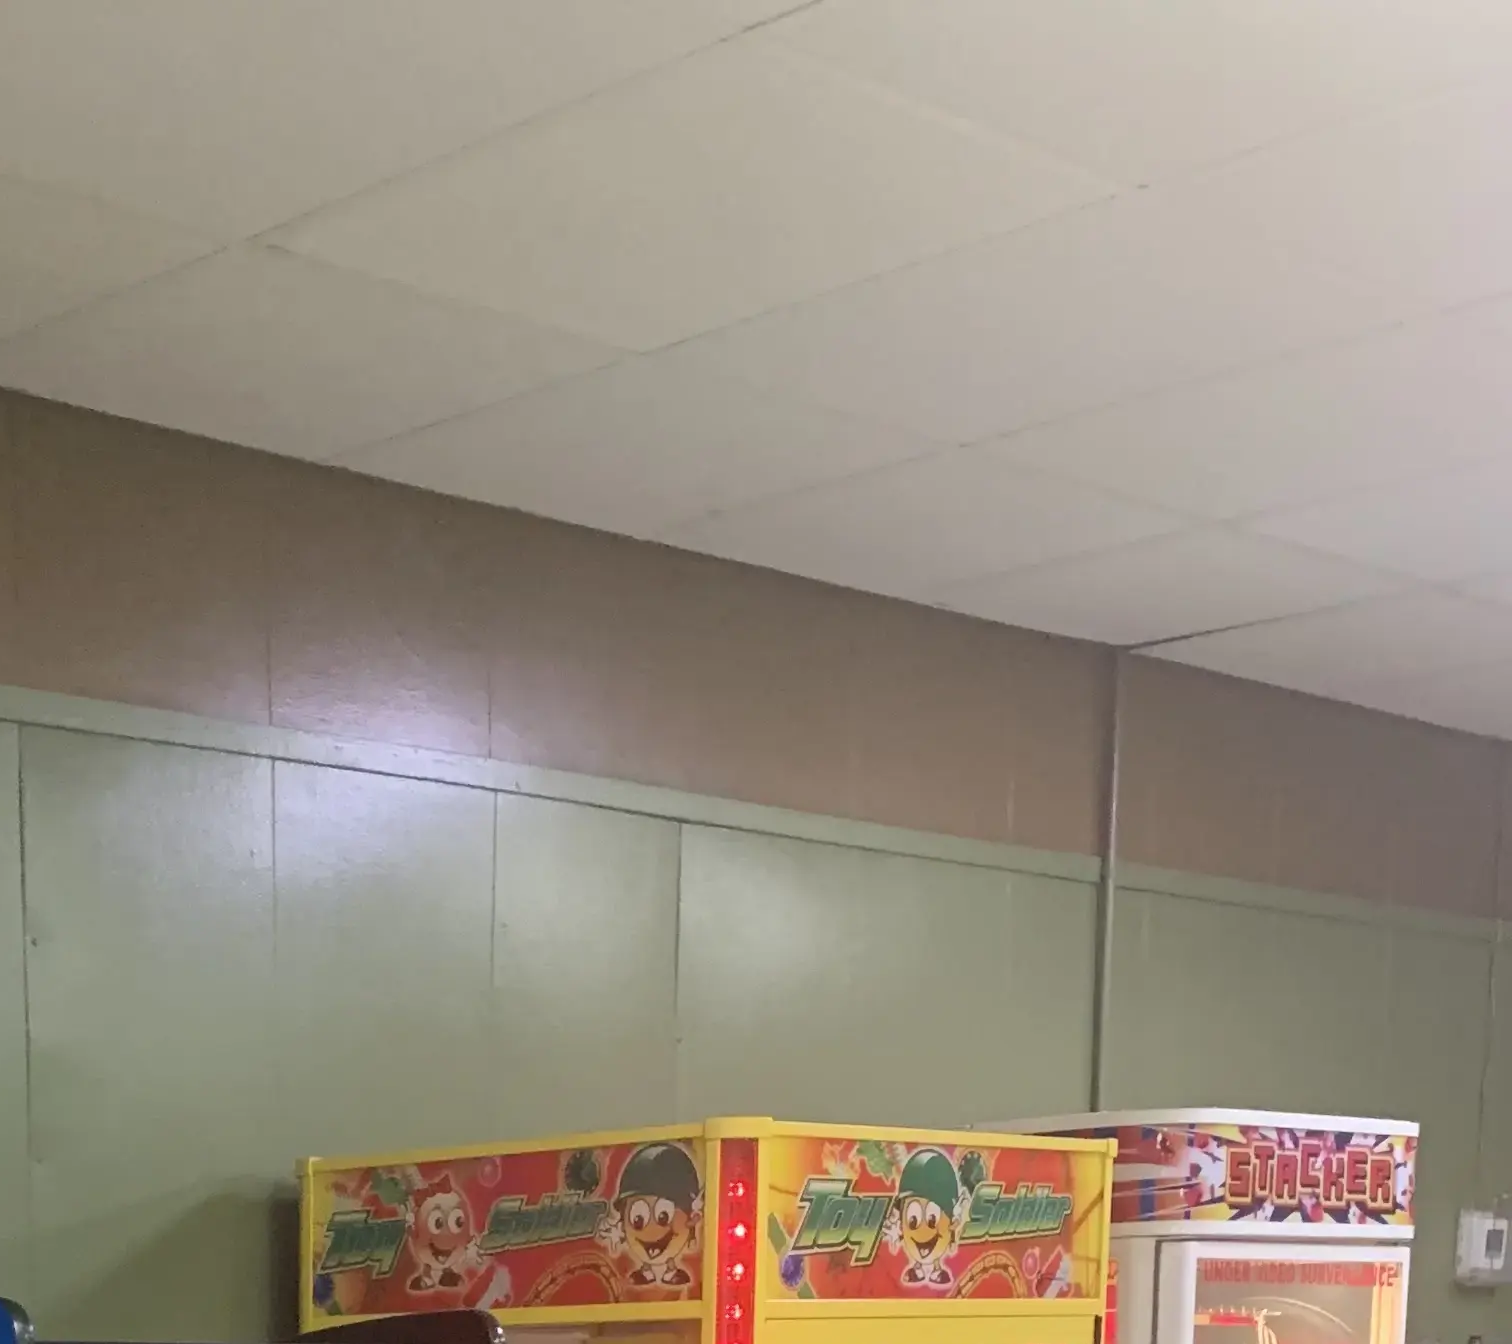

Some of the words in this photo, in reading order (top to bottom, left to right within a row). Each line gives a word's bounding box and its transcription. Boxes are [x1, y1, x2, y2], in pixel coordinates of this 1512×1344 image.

[1227, 1141, 1395, 1211] STACKER
[792, 1177, 893, 1265] Toy
[961, 1184, 1072, 1240] Soldier
